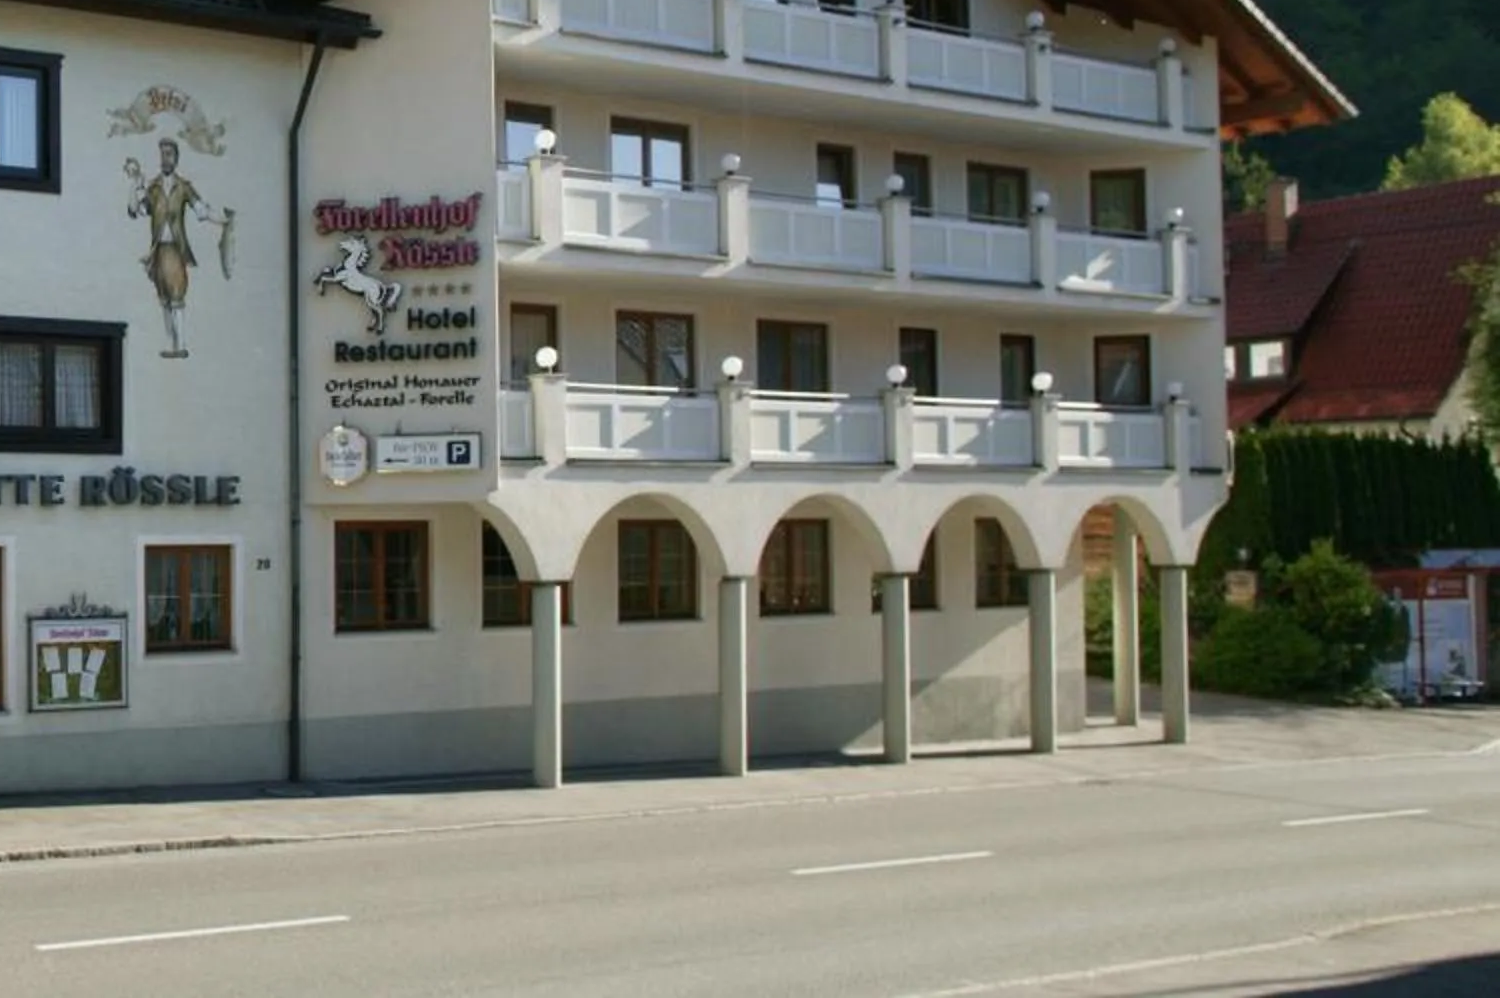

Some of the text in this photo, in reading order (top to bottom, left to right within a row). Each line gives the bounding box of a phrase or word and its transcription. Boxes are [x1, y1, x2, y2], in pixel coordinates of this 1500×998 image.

[407, 306, 475, 331] Hotel
[334, 337, 477, 363] Restaurant
[325, 374, 481, 393] Original Honauer
[420, 390, 475, 407] Forelle
[80, 465, 241, 507] RÖSSLE
